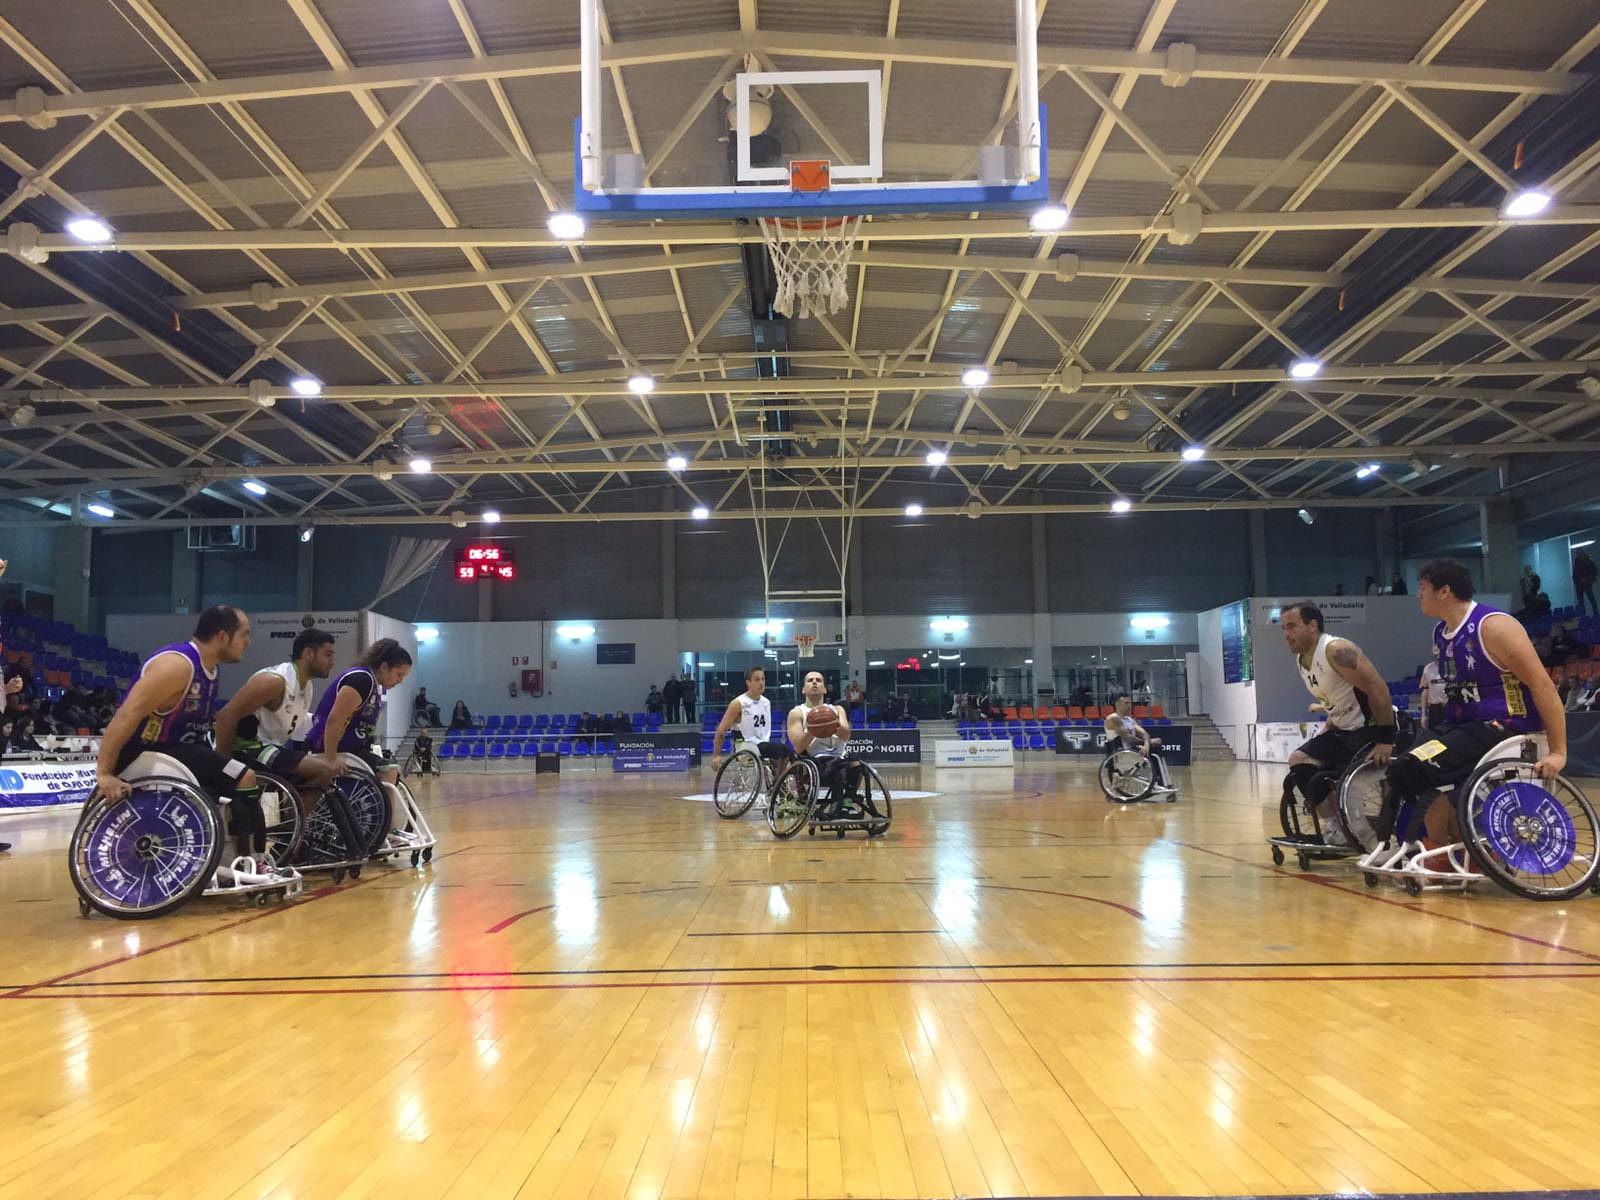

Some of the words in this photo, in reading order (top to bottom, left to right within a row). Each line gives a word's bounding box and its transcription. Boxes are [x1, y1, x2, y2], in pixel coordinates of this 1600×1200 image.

[469, 548, 499, 560] 06:56
[460, 567, 474, 578] 59
[498, 567, 512, 578] 45
[270, 631, 296, 639] FMD
[1307, 674, 1318, 687] 14
[753, 714, 766, 727] 24
[881, 745, 915, 753] NORTE
[21, 771, 74, 781] Fundación
[47, 781, 61, 790] de
[98, 809, 132, 868] MICHELIN
